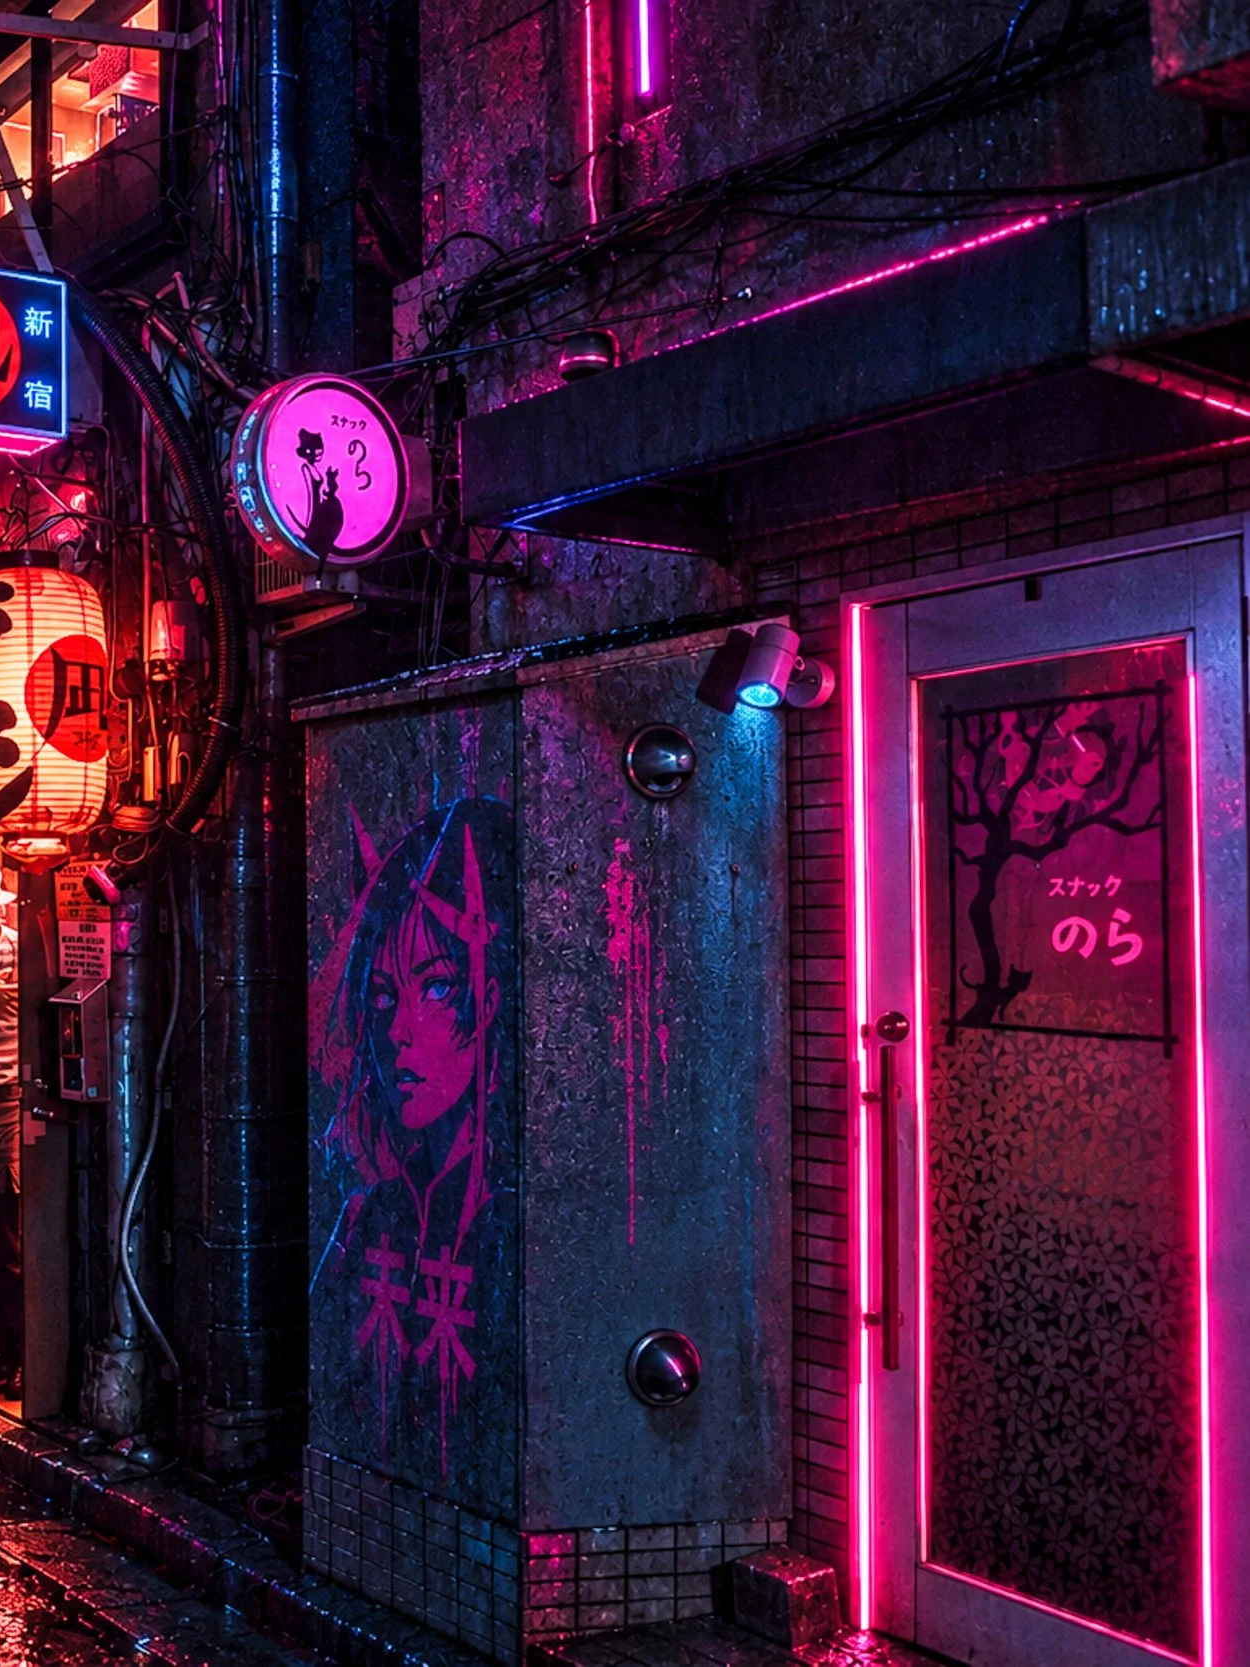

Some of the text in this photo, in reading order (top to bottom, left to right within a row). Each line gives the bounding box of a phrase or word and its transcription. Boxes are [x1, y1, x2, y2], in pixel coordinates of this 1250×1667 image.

[24, 307, 54, 411] 新宿
[330, 415, 367, 431] スナック
[348, 439, 372, 491] のら
[1049, 875, 1122, 897] スナック
[1052, 908, 1143, 966] のら
[356, 1232, 477, 1382] 未来
